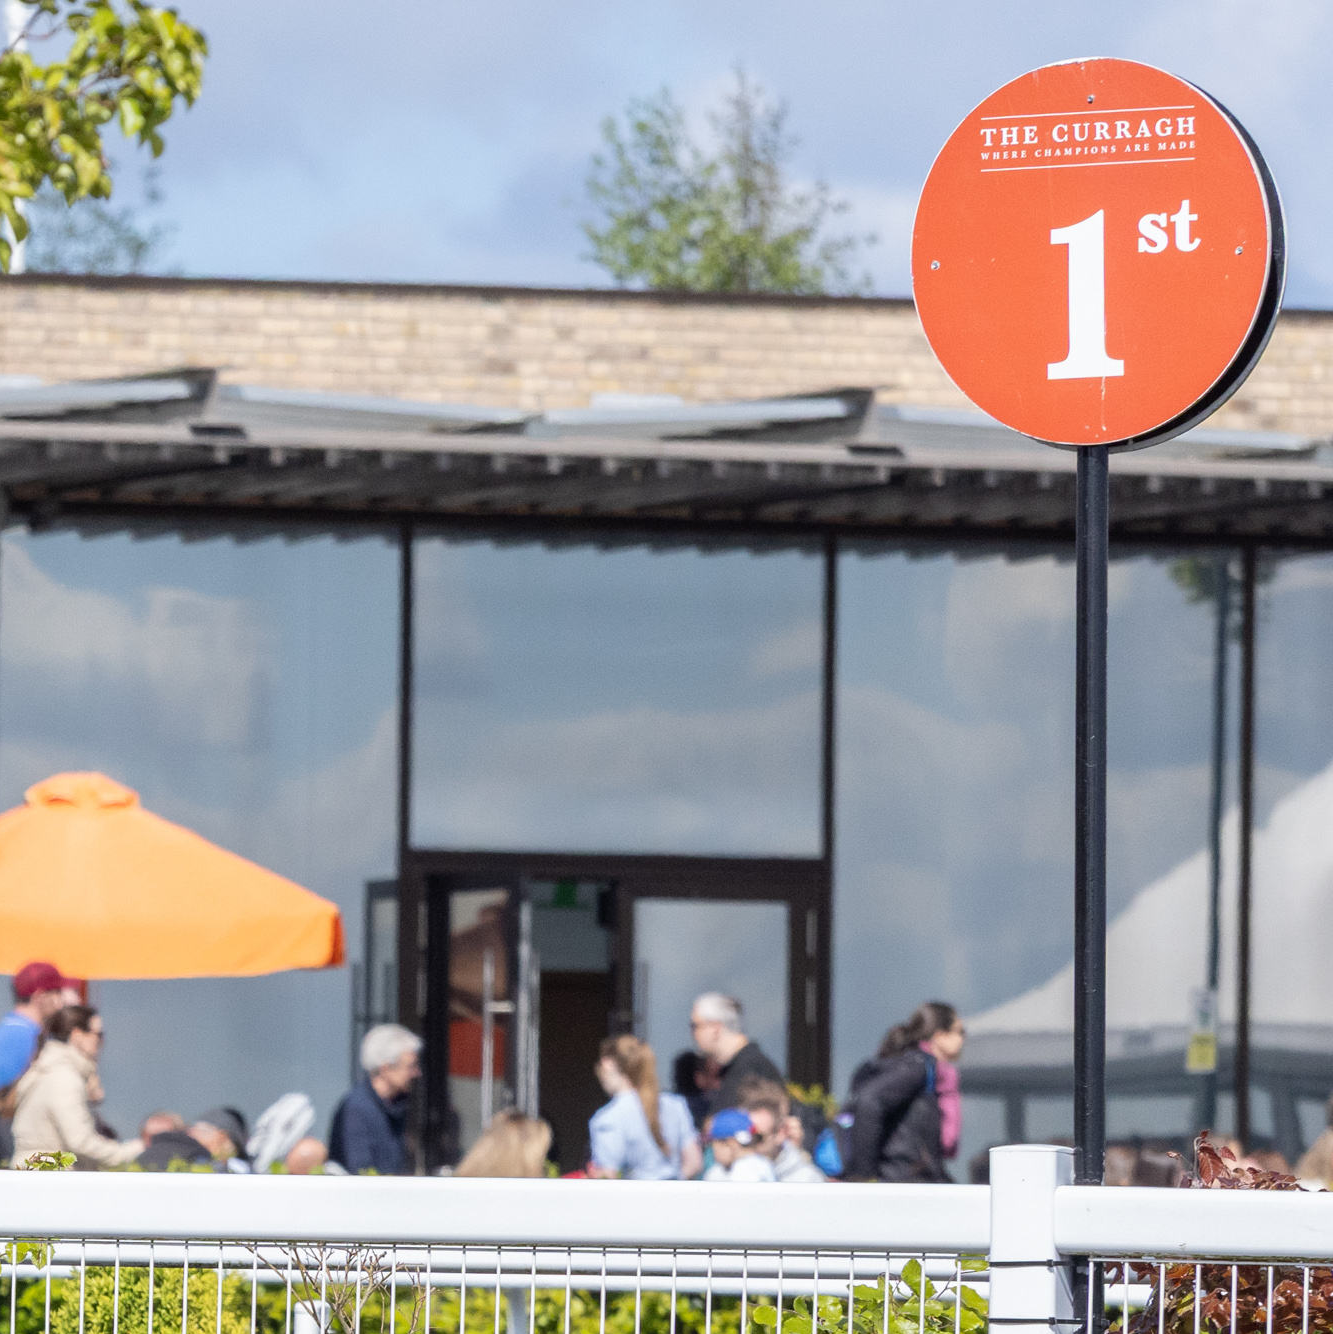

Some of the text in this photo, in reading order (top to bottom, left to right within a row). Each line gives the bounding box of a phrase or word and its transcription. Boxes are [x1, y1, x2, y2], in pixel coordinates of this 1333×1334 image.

[979, 116, 1196, 147] THE CURRAGH
[980, 140, 1196, 161] WHERE CHAMPIONS ARE MADE
